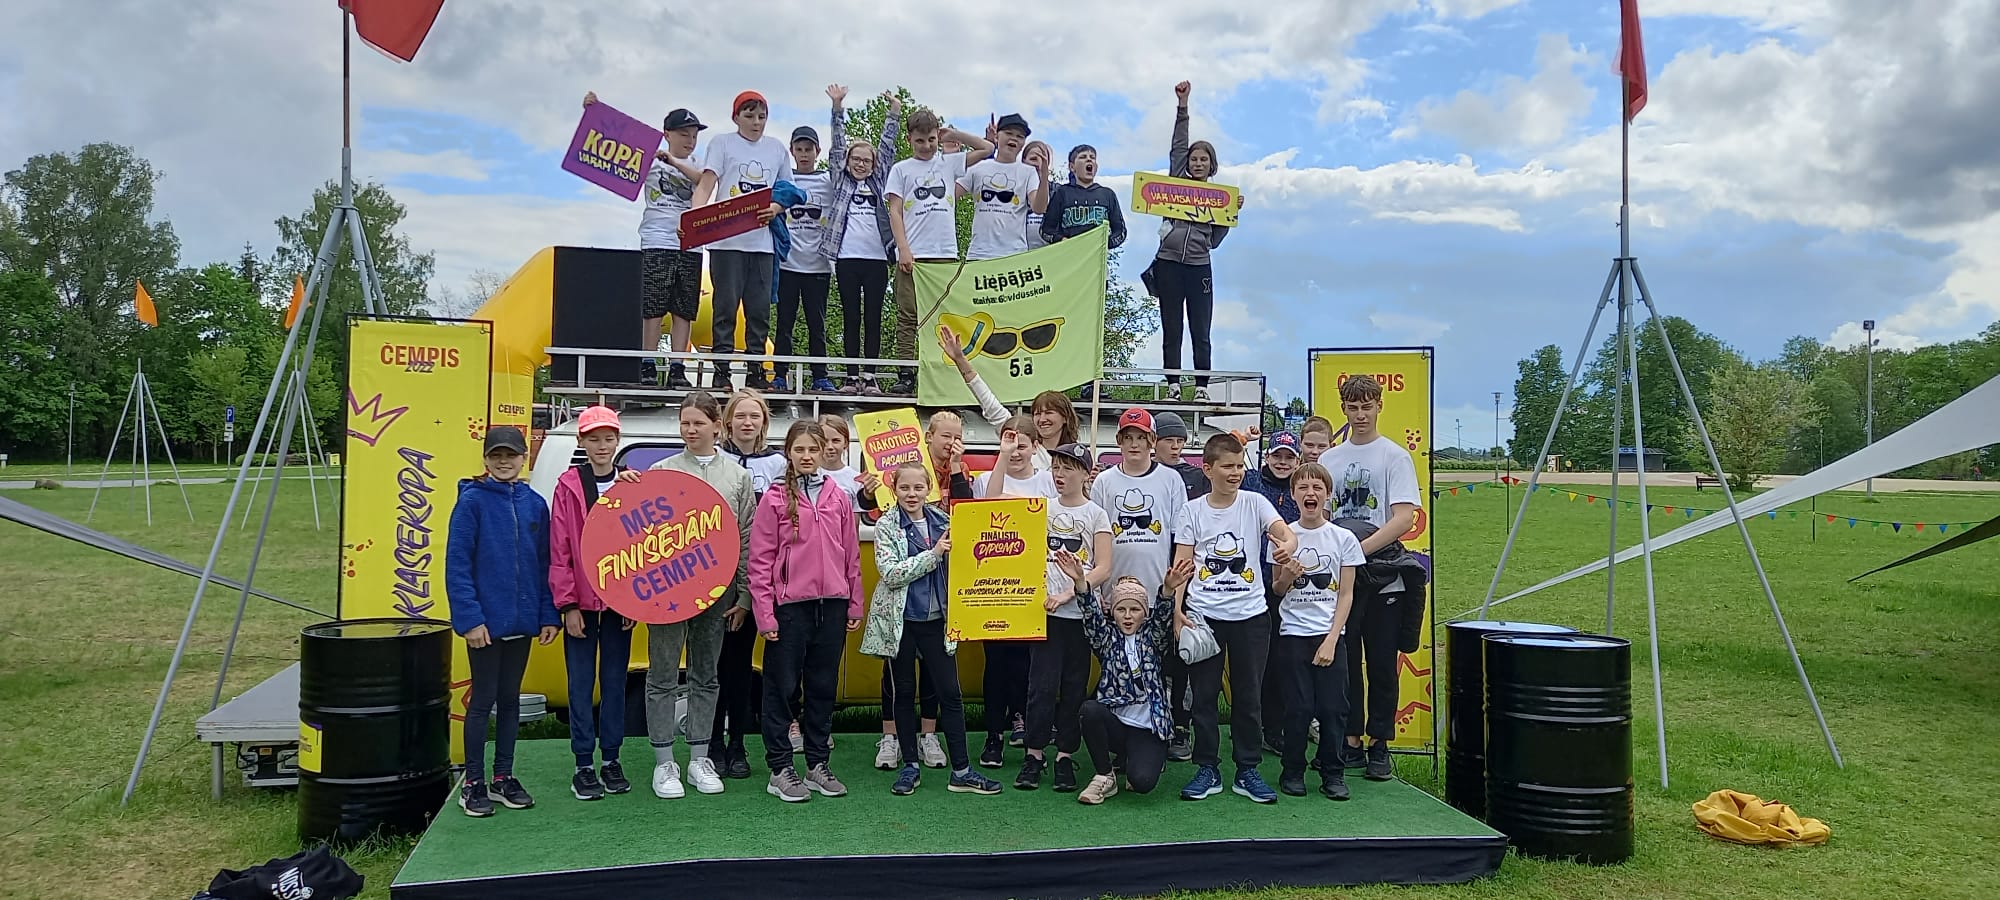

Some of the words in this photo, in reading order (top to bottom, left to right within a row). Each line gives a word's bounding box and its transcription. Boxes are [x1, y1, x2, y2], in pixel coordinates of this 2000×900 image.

[583, 128, 645, 173] KOPĀ
[1150, 191, 1169, 202] VAR
[1171, 195, 1191, 204] VISA
[1192, 196, 1223, 207] KLASE
[974, 264, 1044, 292] Liepājas
[1007, 283, 1051, 302] vidusskola
[380, 342, 459, 368] ČEMPIS
[404, 361, 435, 373] 2022
[227, 408, 232, 421] P
[498, 403, 526, 415] ČEMPIS
[868, 431, 918, 453] NĀKOTNES
[619, 495, 675, 538] MĒS
[596, 504, 722, 591] FINIŠĒJĀM
[978, 541, 1021, 556] DIPLOMS
[631, 542, 719, 601] ČEMPĪ!
